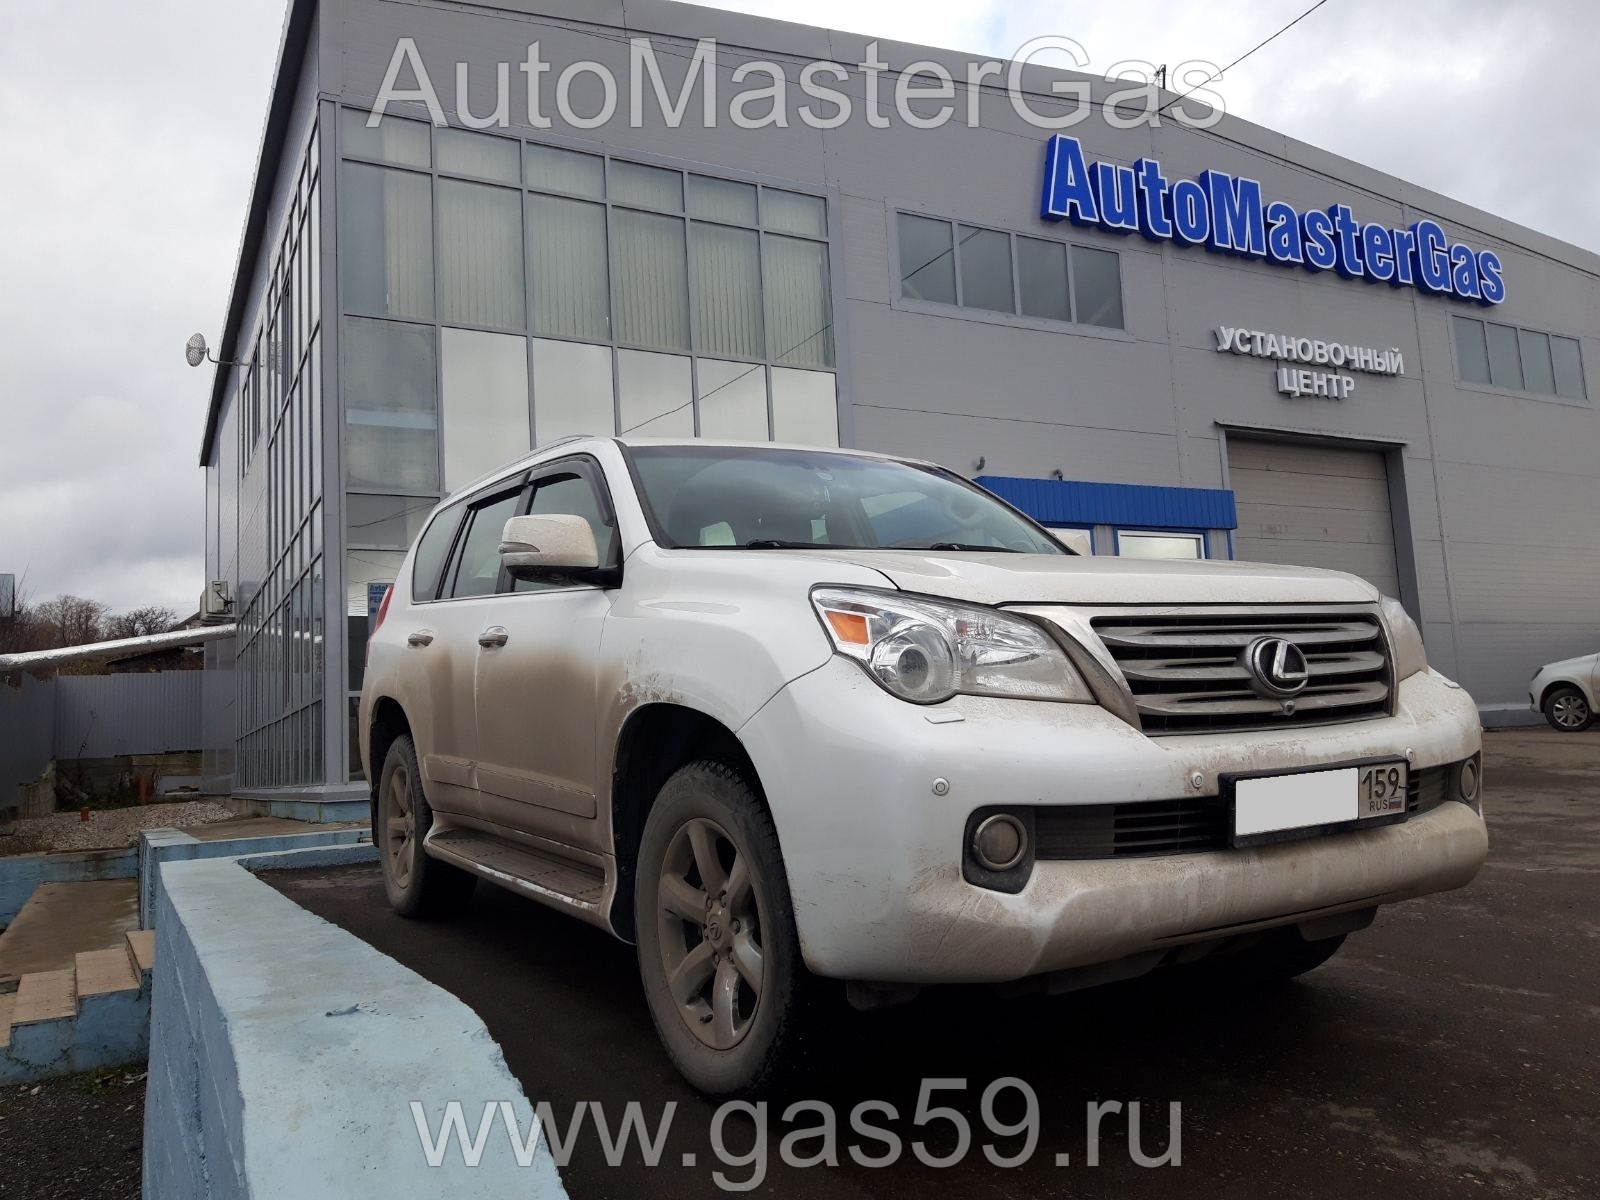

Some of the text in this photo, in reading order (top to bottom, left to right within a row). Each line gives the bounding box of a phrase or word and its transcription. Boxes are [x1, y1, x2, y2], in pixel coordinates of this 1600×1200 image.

[1042, 133, 1506, 305] AutoMasterGas
[1215, 325, 1405, 375] УСТАНОВОЧНЫЙ
[1278, 367, 1355, 398] ЦЕНТР
[1362, 767, 1400, 799] 159
[1369, 799, 1388, 812] RUS
